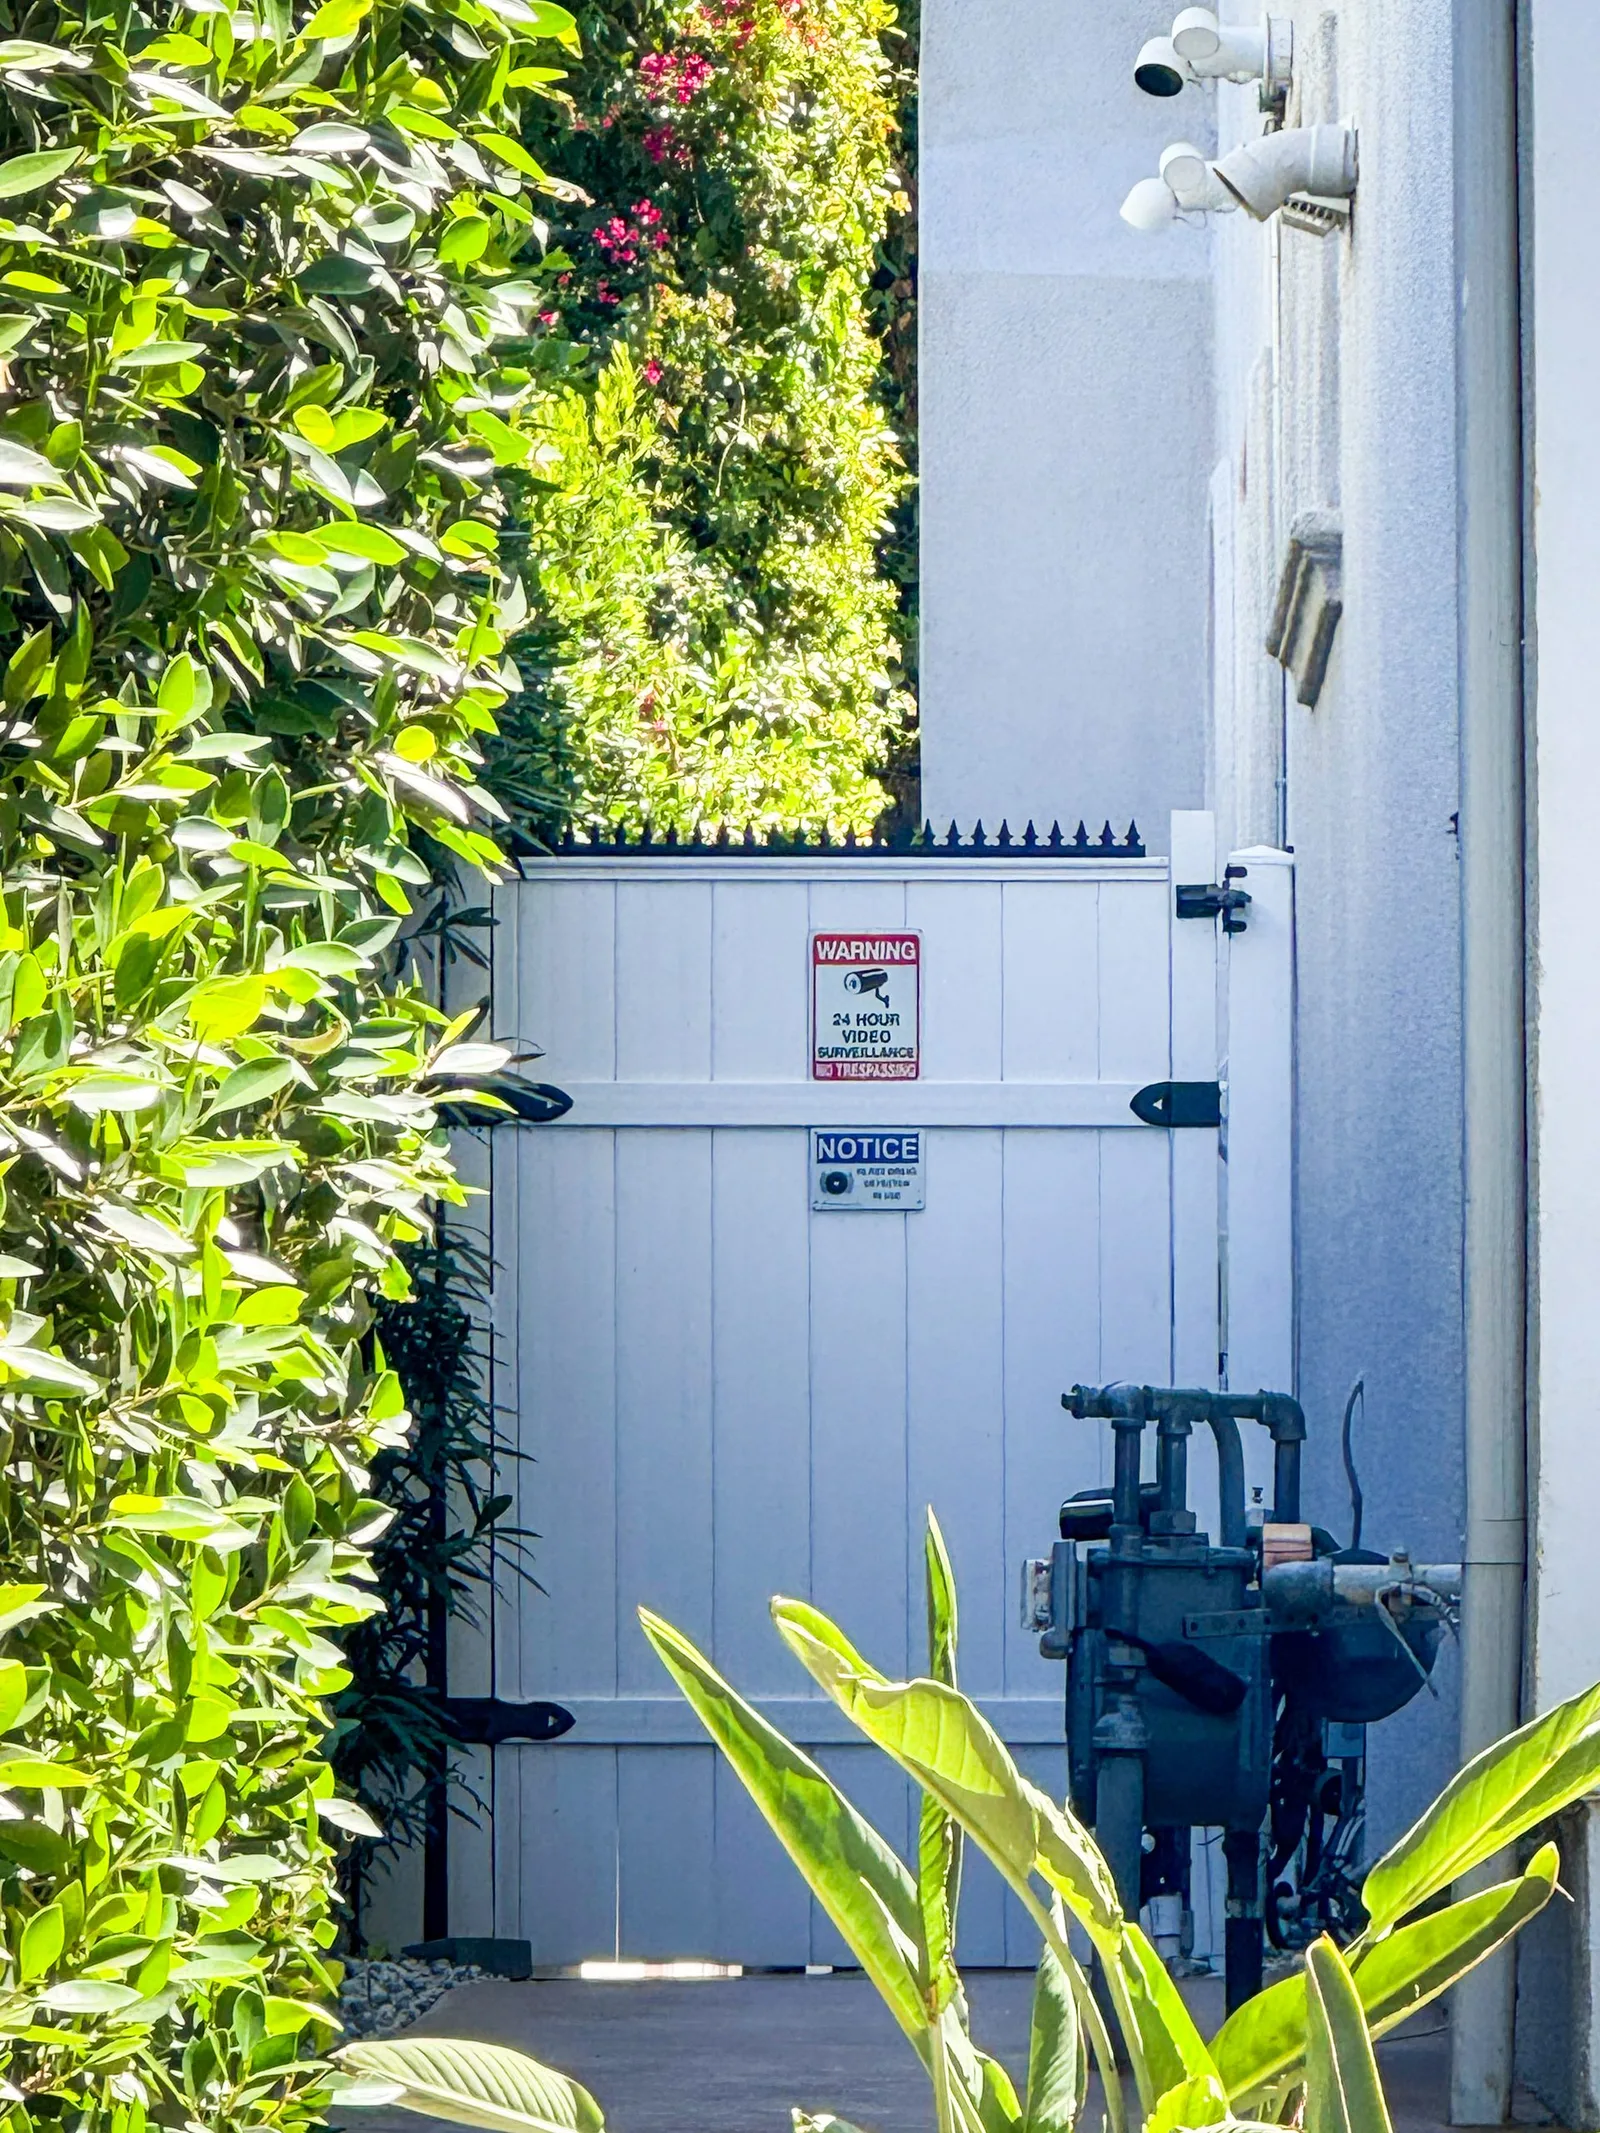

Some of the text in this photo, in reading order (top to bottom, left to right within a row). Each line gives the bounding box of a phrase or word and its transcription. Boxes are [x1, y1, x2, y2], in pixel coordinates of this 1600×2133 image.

[816, 941, 916, 960] WARNING
[832, 1013, 900, 1026] 24 HOUR
[842, 1030, 891, 1043] VIDEO
[818, 1047, 914, 1059] SURVEILLANCE
[818, 1138, 918, 1160] NOTICE
